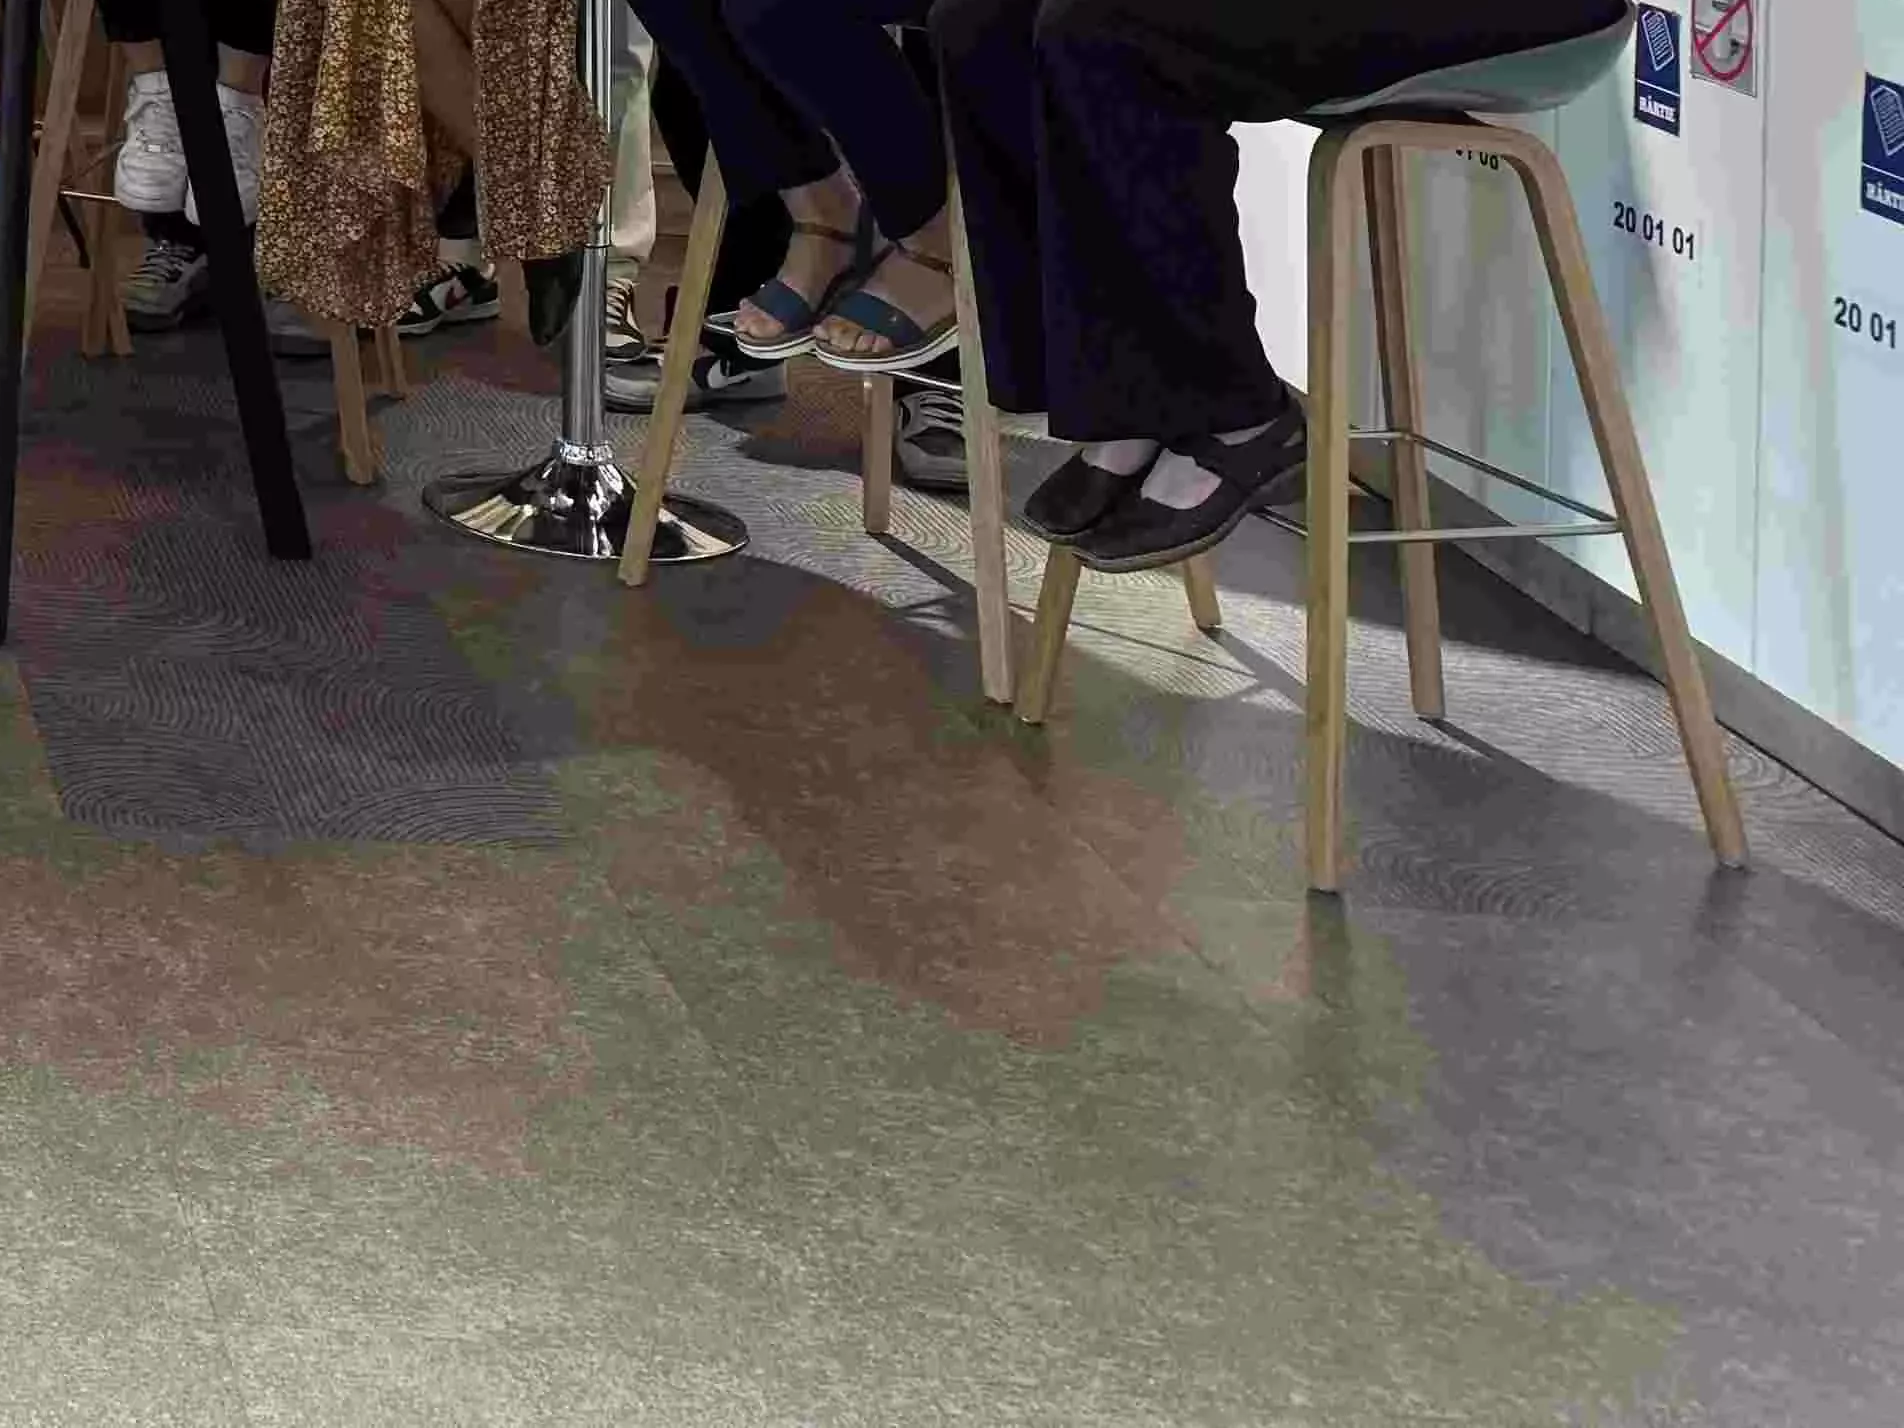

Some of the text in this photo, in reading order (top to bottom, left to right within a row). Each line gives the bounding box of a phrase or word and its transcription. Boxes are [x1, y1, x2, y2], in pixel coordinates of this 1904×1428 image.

[1614, 201, 1694, 260] 20 01 01
[1834, 297, 1896, 349] 20 01
